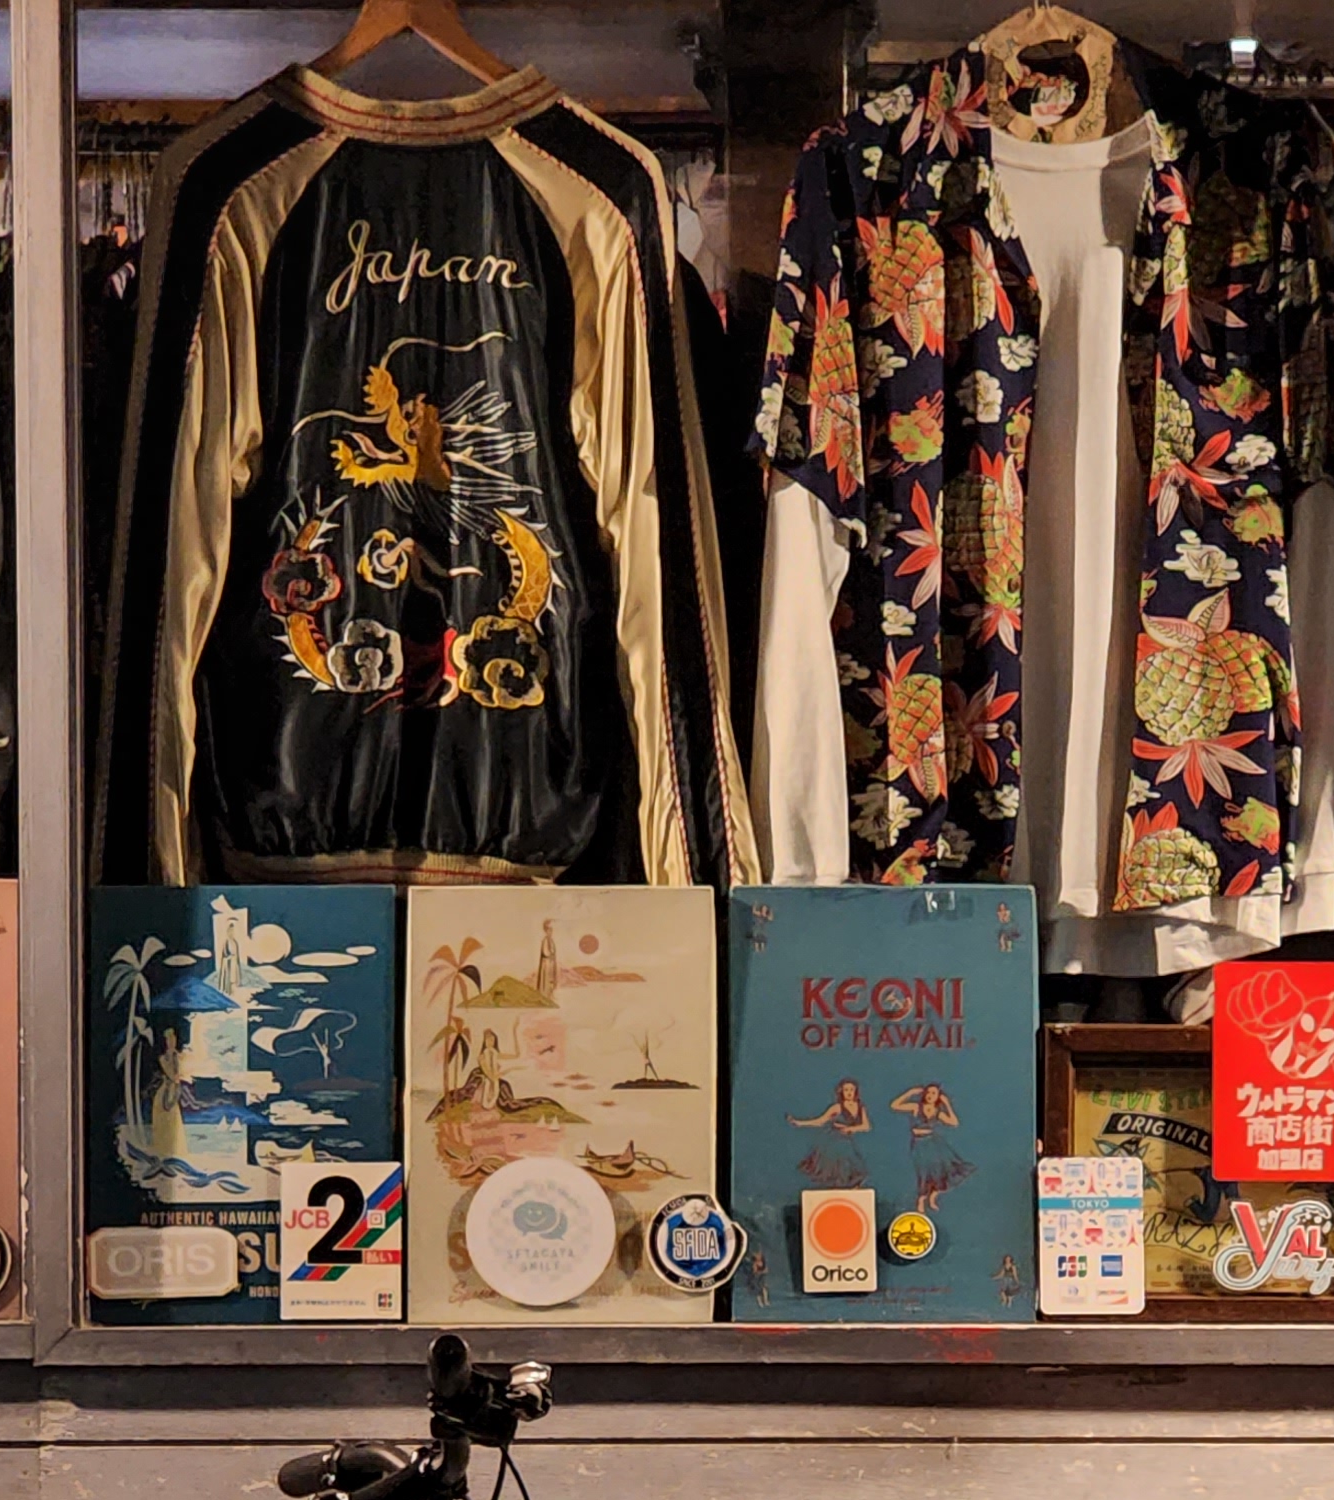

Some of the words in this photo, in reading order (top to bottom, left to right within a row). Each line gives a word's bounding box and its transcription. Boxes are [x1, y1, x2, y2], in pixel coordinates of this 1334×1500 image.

[326, 219, 534, 314] Japan
[801, 977, 966, 1022] KEONI
[801, 1023, 843, 1049] OF
[852, 1022, 966, 1049] HAWAII
[1117, 1114, 1210, 1152] ORIGINAL
[1246, 1115, 1334, 1147] 商店街
[1257, 1148, 1324, 1171] 加盟店
[140, 1210, 216, 1227] AUTHENTIC
[284, 1209, 330, 1230] JCB
[307, 1175, 365, 1264] 2
[1071, 1199, 1110, 1209] TOKYO
[672, 1227, 721, 1261] SFIDA
[108, 1244, 217, 1278] ORIS
[811, 1264, 869, 1283] Orico
